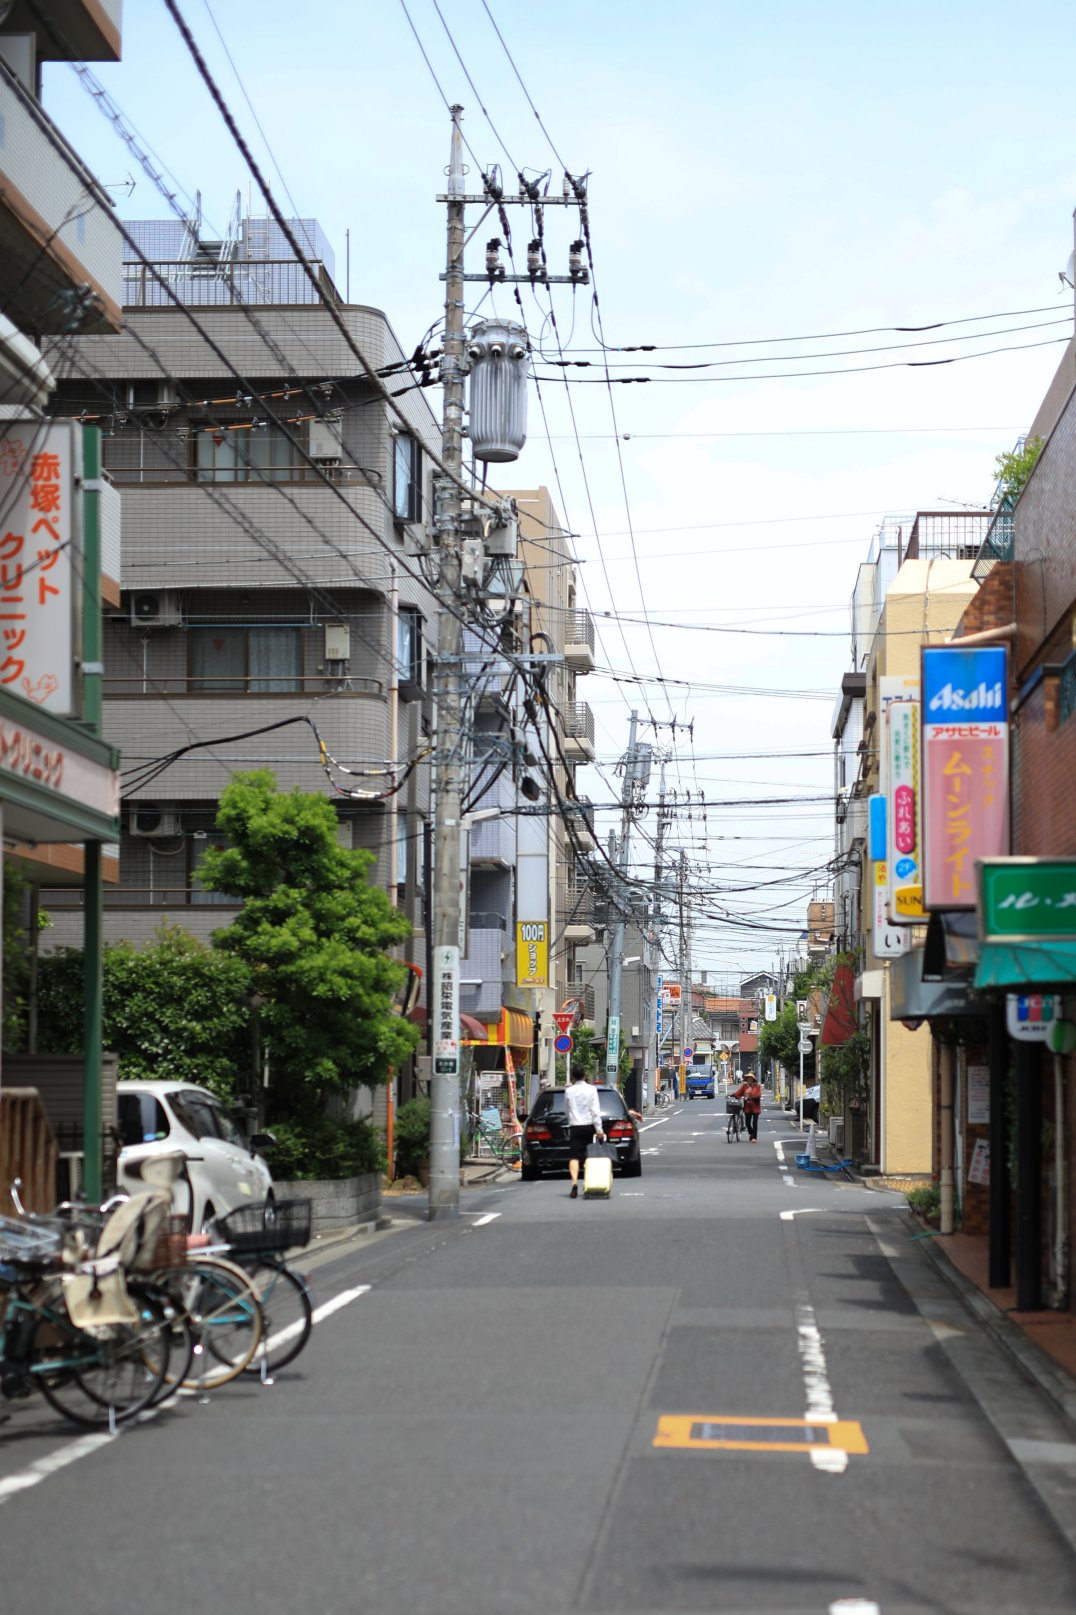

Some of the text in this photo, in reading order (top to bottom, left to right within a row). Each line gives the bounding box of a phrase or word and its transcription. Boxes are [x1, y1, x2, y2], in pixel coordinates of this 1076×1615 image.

[30, 452, 61, 605] 赤塚ペット
[0, 532, 26, 685] クリニック
[928, 681, 1002, 712] Asahi
[932, 725, 1000, 738] アサヒビール
[897, 790, 912, 848] ふれあい
[943, 751, 972, 898] ムーンライト
[521, 924, 545, 942] 100円
[528, 943, 538, 976] ショップ
